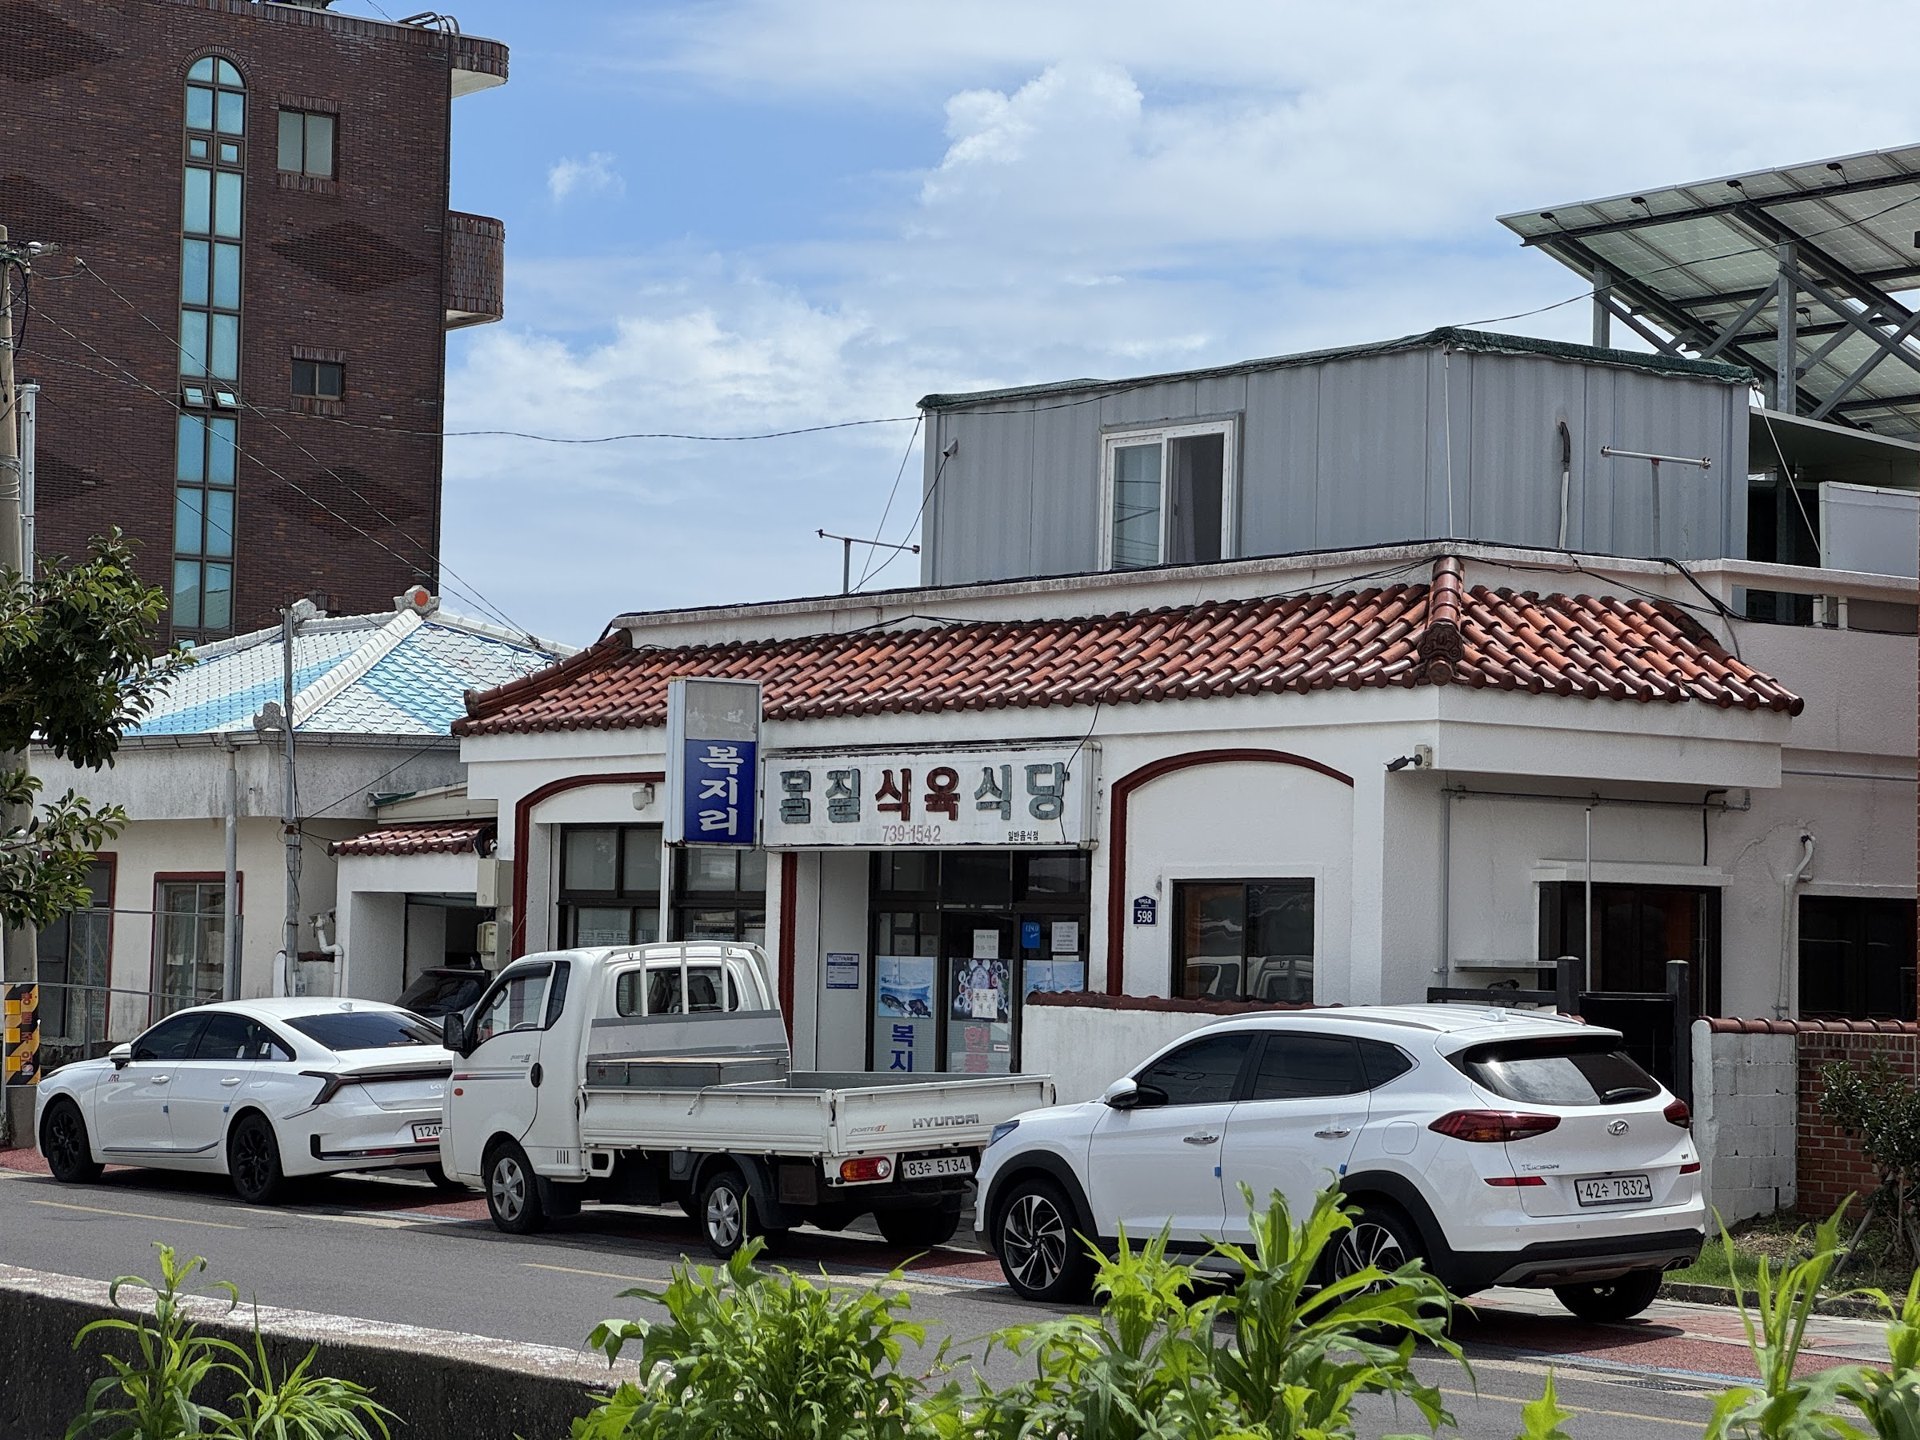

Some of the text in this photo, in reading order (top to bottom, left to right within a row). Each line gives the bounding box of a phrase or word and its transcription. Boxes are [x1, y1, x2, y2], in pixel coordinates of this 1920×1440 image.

[698, 746, 744, 836] 복지리
[882, 825, 941, 843] 739-1542
[1008, 830, 1039, 842] 일반음식점
[1137, 910, 1152, 923] 598
[890, 1024, 914, 1072] 복지
[912, 1114, 980, 1129] HYUNDAI
[909, 1158, 967, 1176] 83수 5134
[1586, 1179, 1645, 1199] 42수 7832
